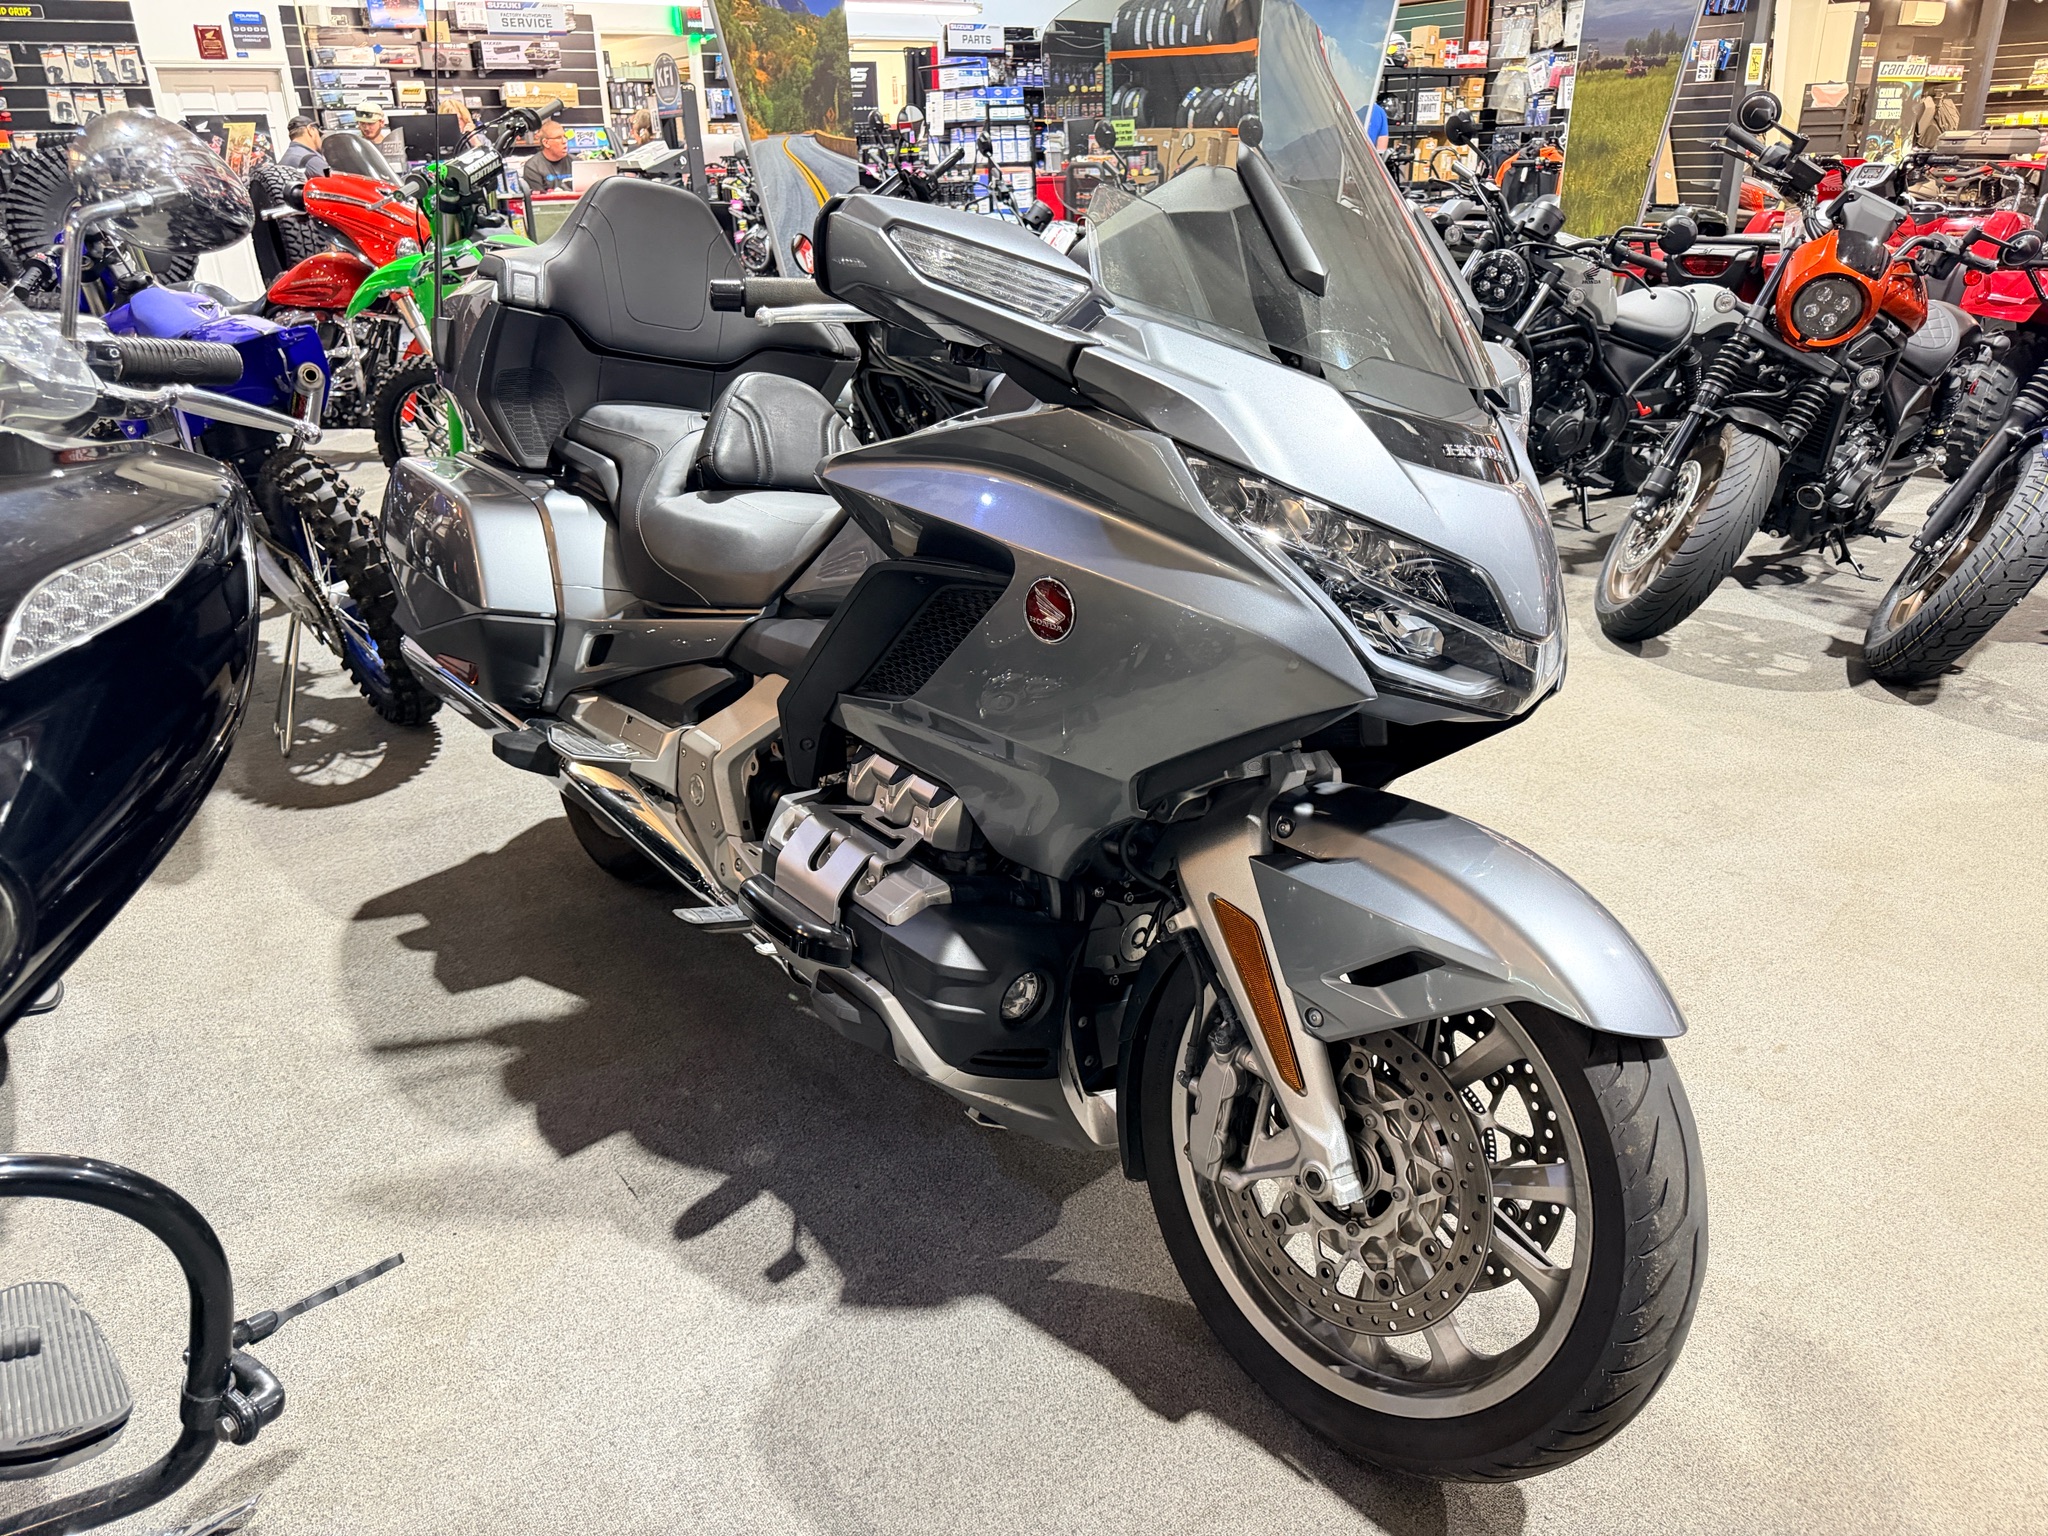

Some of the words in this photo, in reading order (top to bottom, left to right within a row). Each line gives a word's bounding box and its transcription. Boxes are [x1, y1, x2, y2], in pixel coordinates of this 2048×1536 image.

[8, 7, 32, 16] GRIPS
[502, 18, 553, 28] SERVICE
[961, 34, 992, 44] PARTS
[656, 64, 675, 88] KFI
[470, 158, 502, 185] RENTHAL
[1442, 443, 1510, 465] HONDA
[1029, 615, 1064, 633] HONDA
